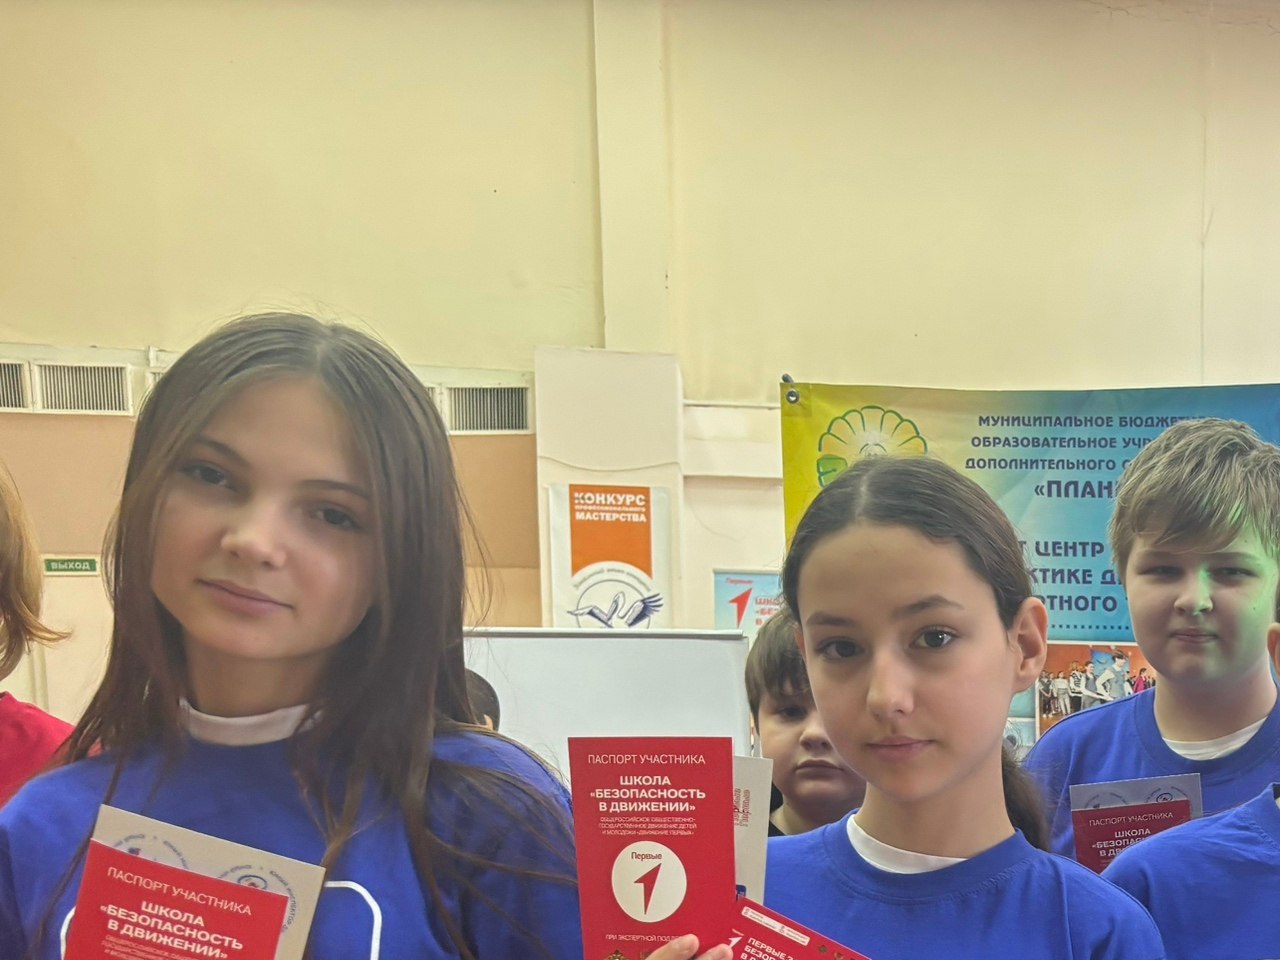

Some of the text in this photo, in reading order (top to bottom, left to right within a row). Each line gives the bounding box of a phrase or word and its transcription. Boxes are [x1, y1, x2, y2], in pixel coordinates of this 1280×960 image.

[978, 415, 1198, 428] МУНИЦИПАЛЬНОЕ БЮДЖЕ
[971, 436, 1152, 449] ОБРАЗОВАТЕЛЬНОЕ УЧР
[965, 458, 1116, 471] ДОПОЛНИТЕЛЬНОГО
[1034, 480, 1118, 499] «ПЛАН
[574, 492, 646, 506] КОНКУРС
[575, 512, 647, 522] МАСТЕРСТВА
[1035, 541, 1104, 557] ЦЕНТР
[51, 561, 91, 570] ВЫХОД
[1028, 567, 1093, 584] КТИКЕ
[1039, 595, 1118, 612] ТНОГО
[588, 754, 706, 765] ПАСПОРТ УЧАСТНИКА
[620, 775, 671, 786] ШКОЛА
[590, 788, 706, 799] «БЕЗОПАСНОСТЬ
[599, 802, 696, 813] В ДВИЖЕНИИ»
[1089, 811, 1173, 827] ПАСПОРТ УЧАСТНИКА
[1114, 828, 1151, 838] ШКОЛА
[1092, 837, 1147, 849] «БЕЗОПАС
[631, 852, 662, 861] Первые
[107, 866, 252, 916] ПАСПОРТ УЧАСТНИКА
[141, 900, 205, 927] ШКОЛА
[100, 904, 244, 951] «БЕЗОПАСНОСТЬ
[107, 919, 228, 960] В ДВИЖЕНИИ»
[748, 938, 786, 960] ПЕРВЫЕ
[740, 953, 748, 960] В
